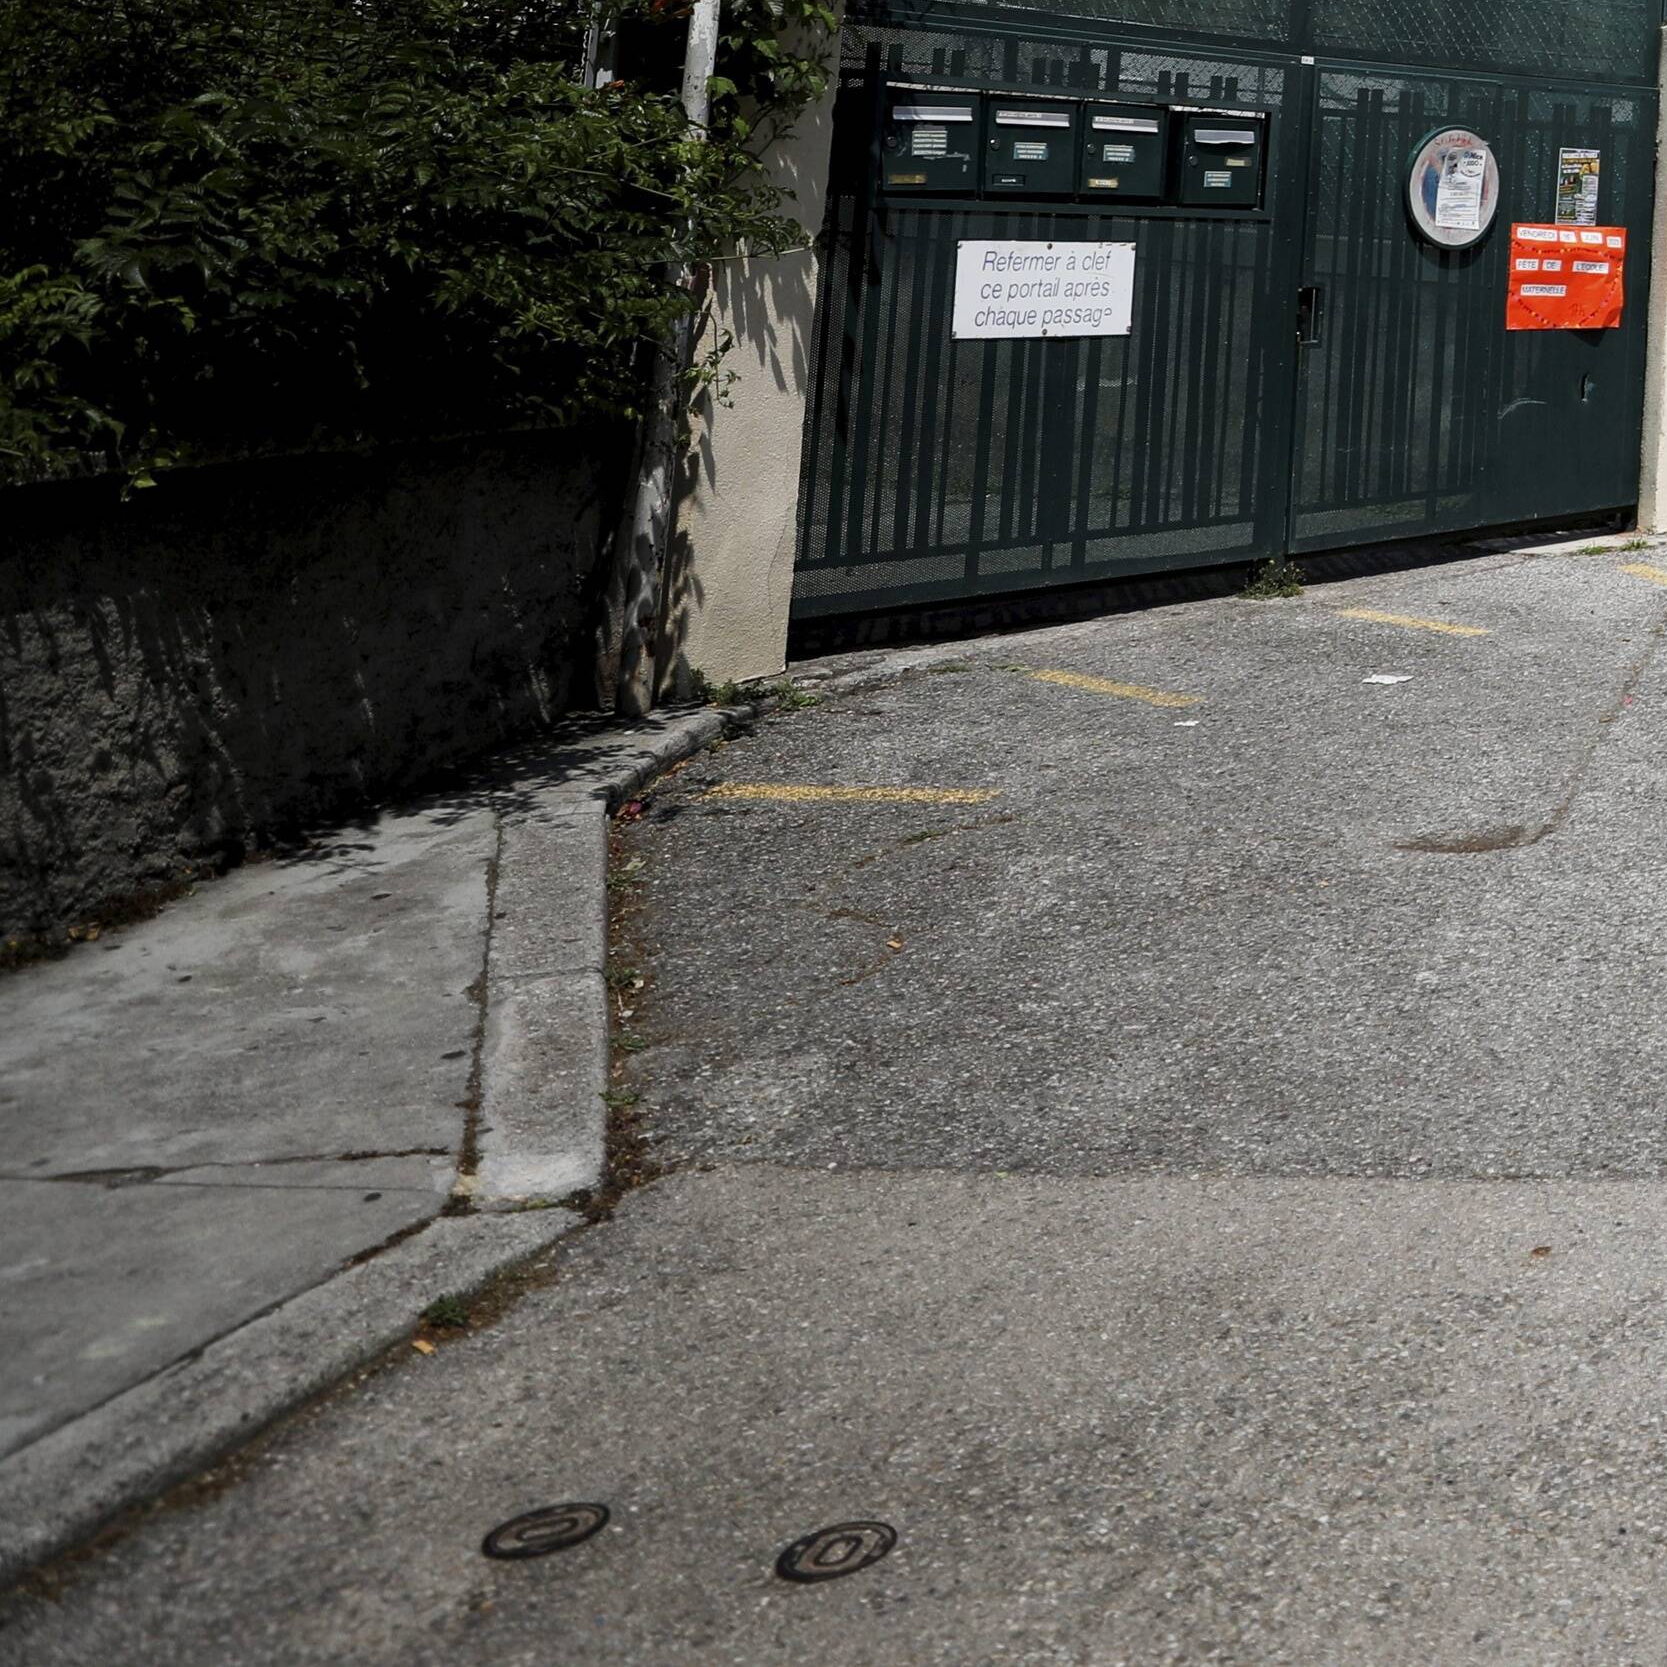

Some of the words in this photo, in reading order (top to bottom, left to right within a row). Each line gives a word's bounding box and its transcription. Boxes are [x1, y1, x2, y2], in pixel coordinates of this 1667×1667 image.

[982, 250, 1061, 272] Refermer
[1066, 251, 1076, 271] à
[1082, 251, 1112, 271] clef
[981, 283, 1002, 299] ce
[1007, 277, 1060, 302] portail
[1064, 277, 1110, 301] après
[975, 306, 1037, 329] chaque
